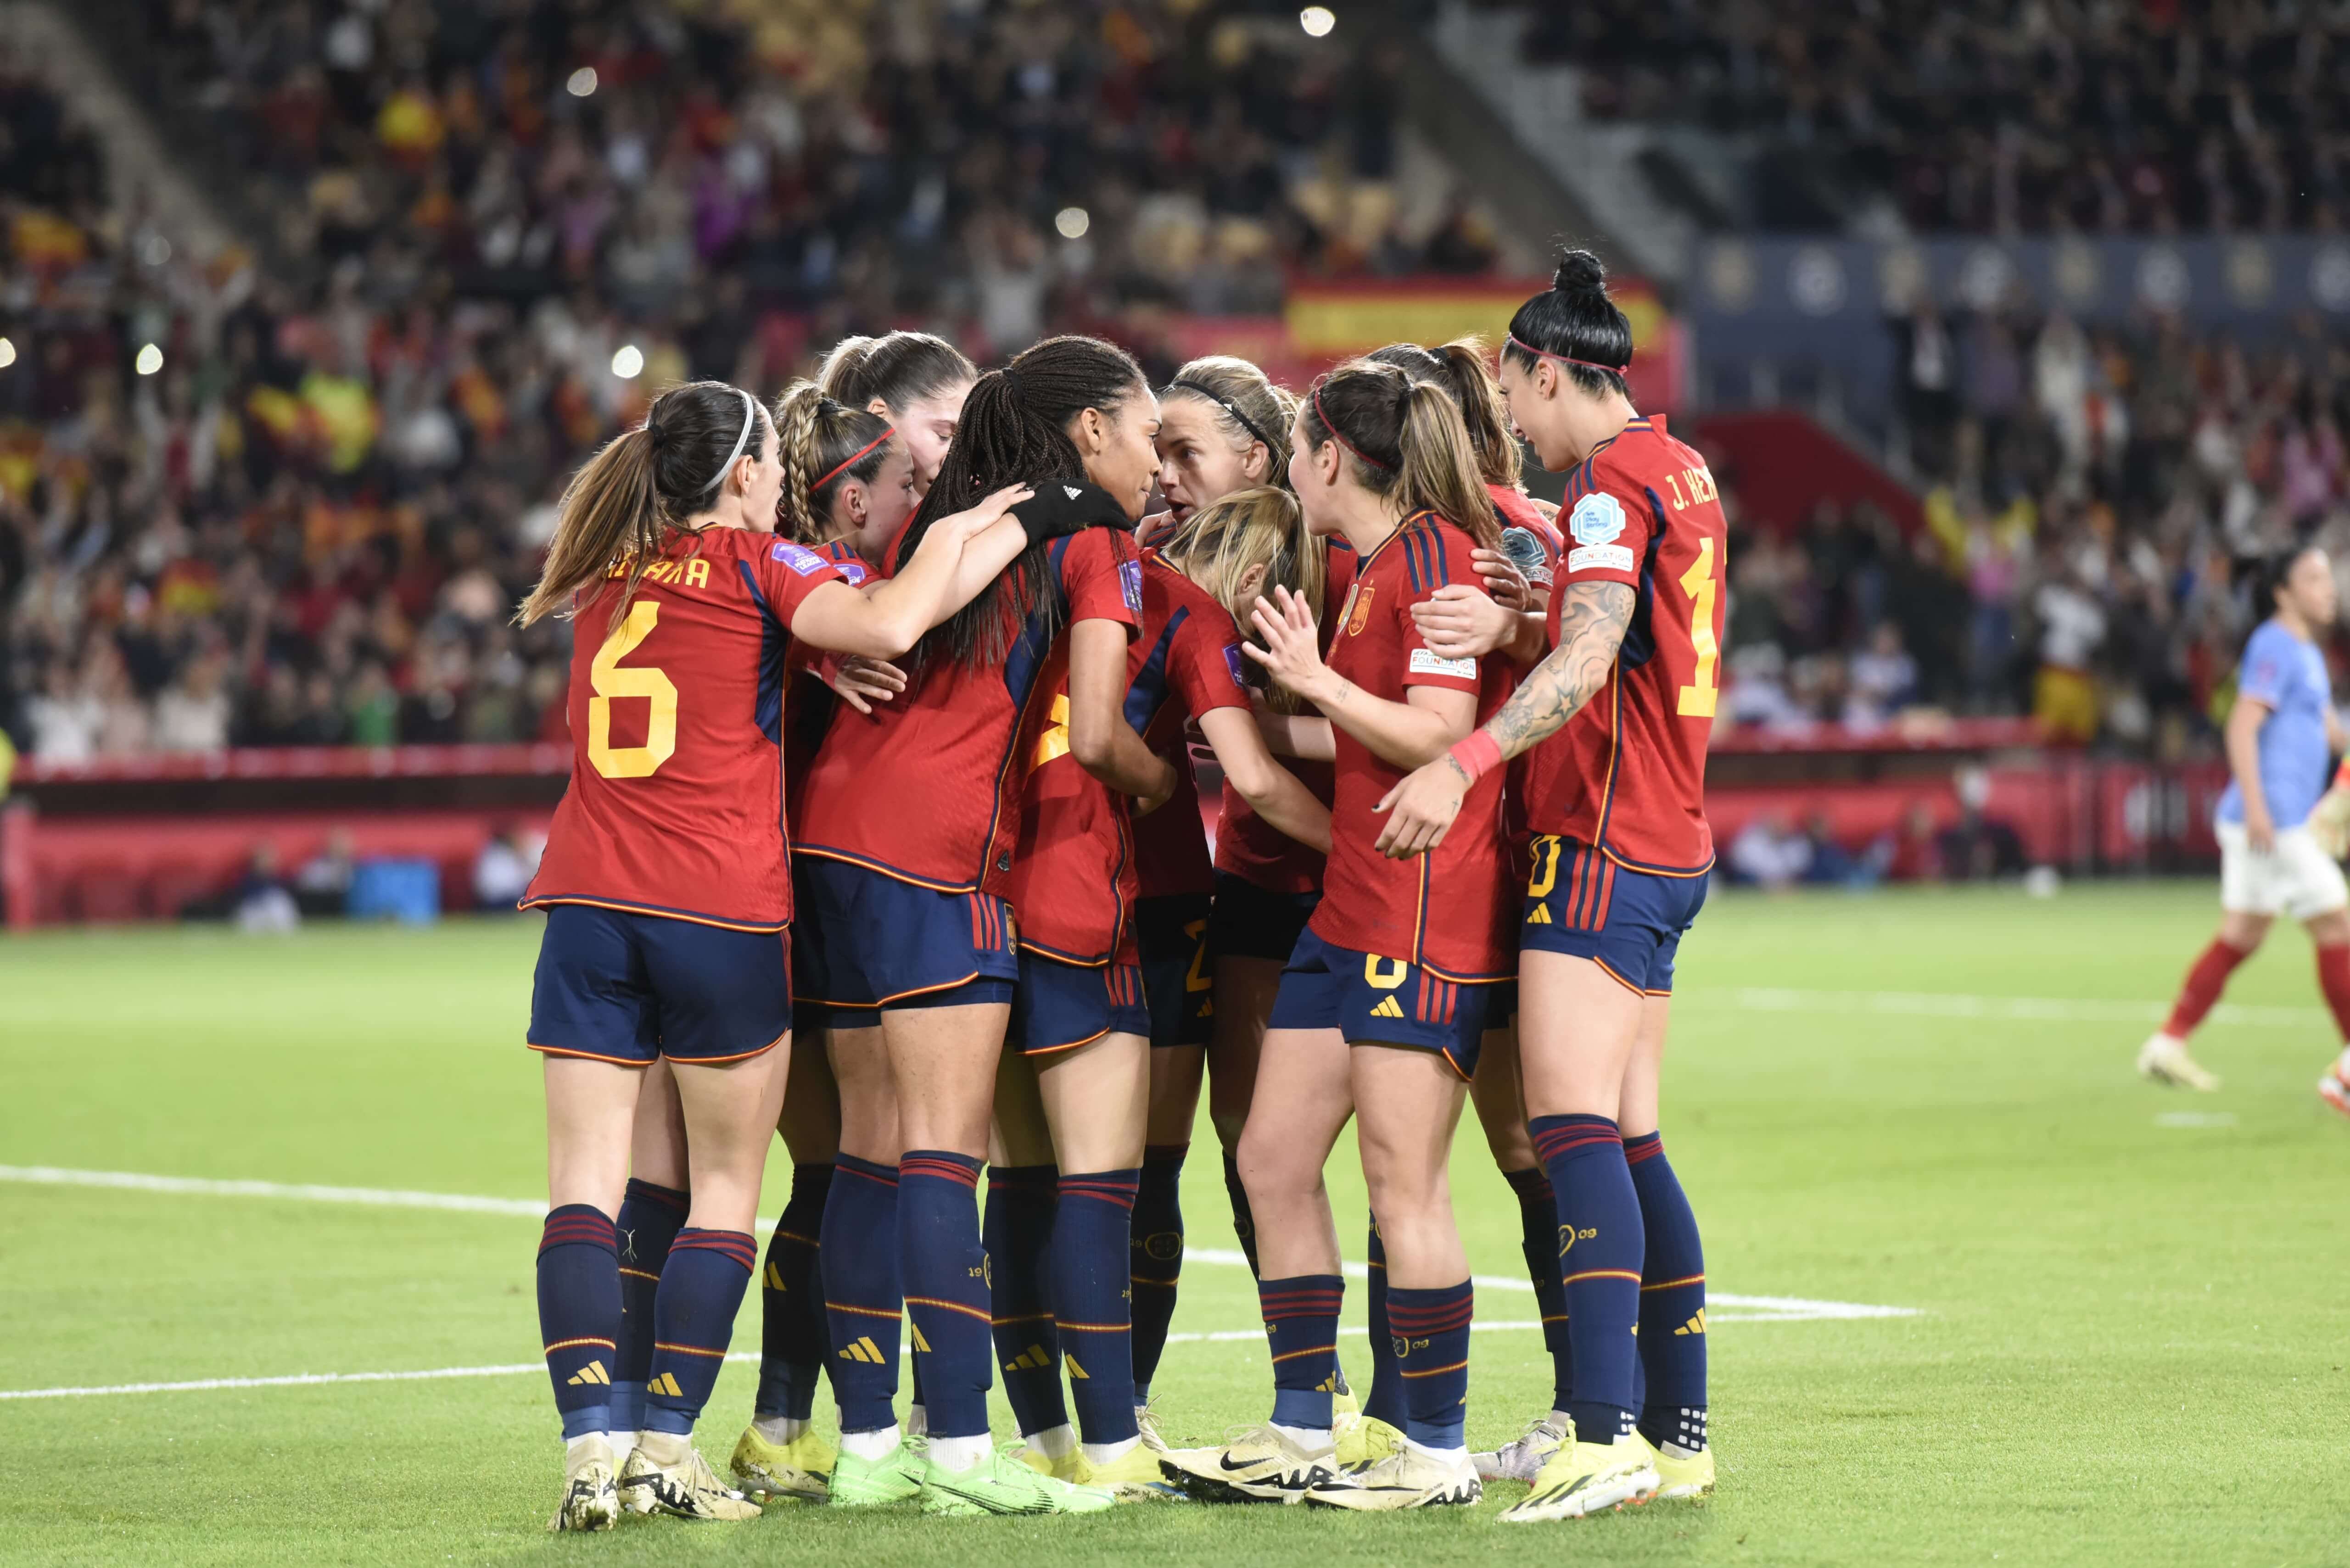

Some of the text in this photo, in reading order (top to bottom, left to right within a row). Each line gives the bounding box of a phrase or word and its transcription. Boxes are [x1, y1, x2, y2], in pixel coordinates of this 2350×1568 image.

[1570, 552, 1631, 563] FOUNDATION
[1677, 536, 1727, 717] 1
[1412, 656, 1476, 672] FOUNDATION
[588, 600, 678, 779] 6
[1578, 1228, 1597, 1239] 09
[968, 1267, 982, 1277] 19
[1267, 1324, 1277, 1334] 09
[1412, 1339, 1430, 1349] 09
